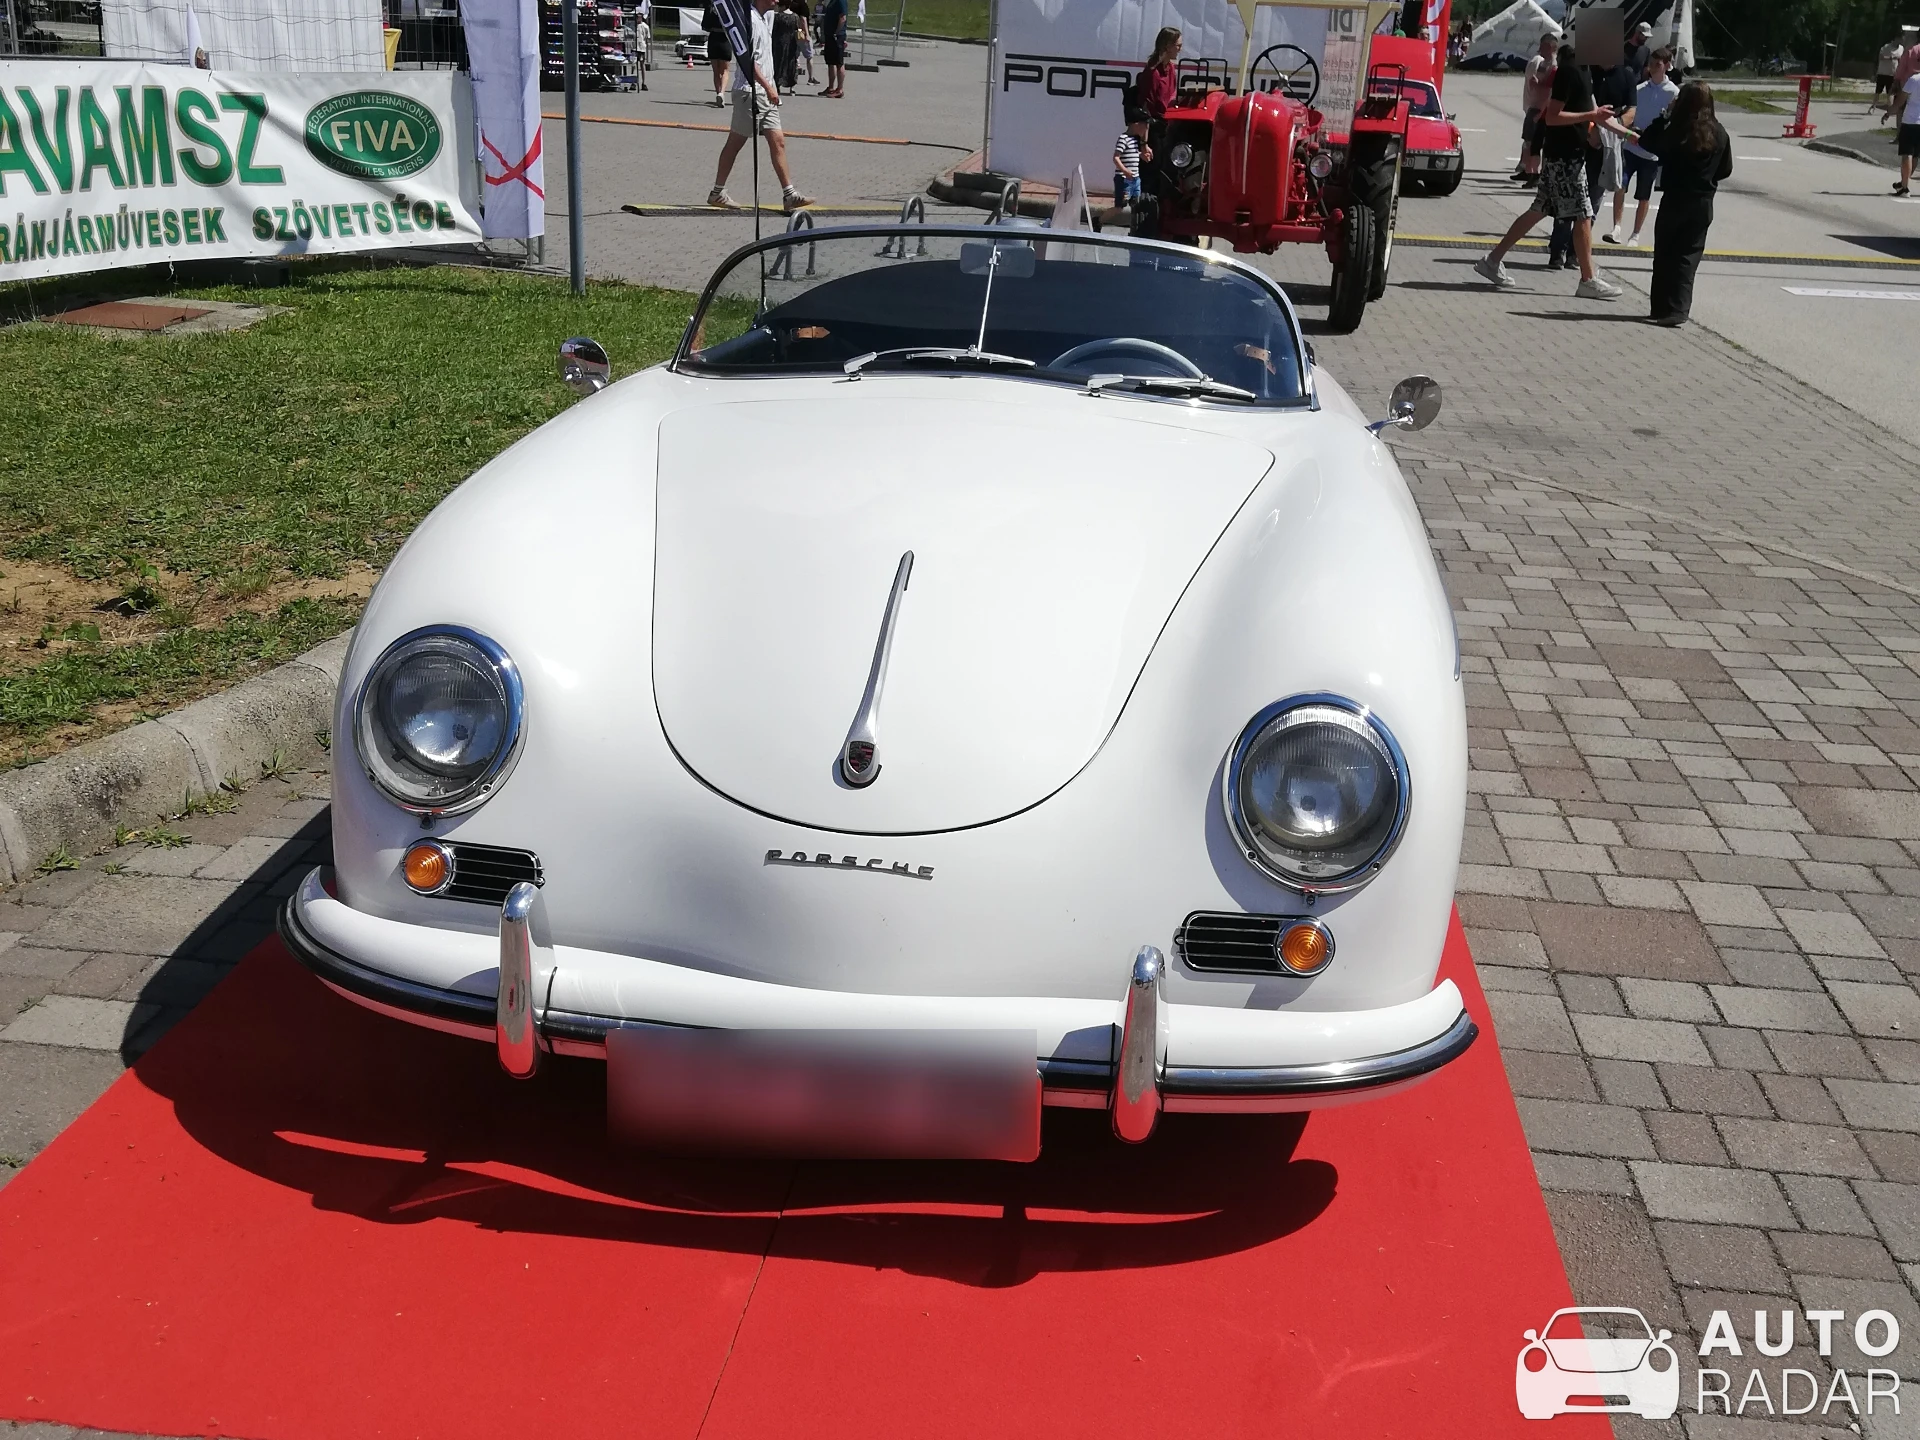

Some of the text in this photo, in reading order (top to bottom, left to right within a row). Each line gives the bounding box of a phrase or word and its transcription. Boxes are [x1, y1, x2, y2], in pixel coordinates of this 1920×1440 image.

[360, 94, 437, 134] INTERNATIONALE
[0, 85, 286, 197] AVAMSZ
[330, 119, 416, 153] FIVA
[387, 155, 424, 176] ANCIENS
[252, 193, 456, 241] SZÖVETSÉGE
[764, 850, 935, 881] PORSCHE
